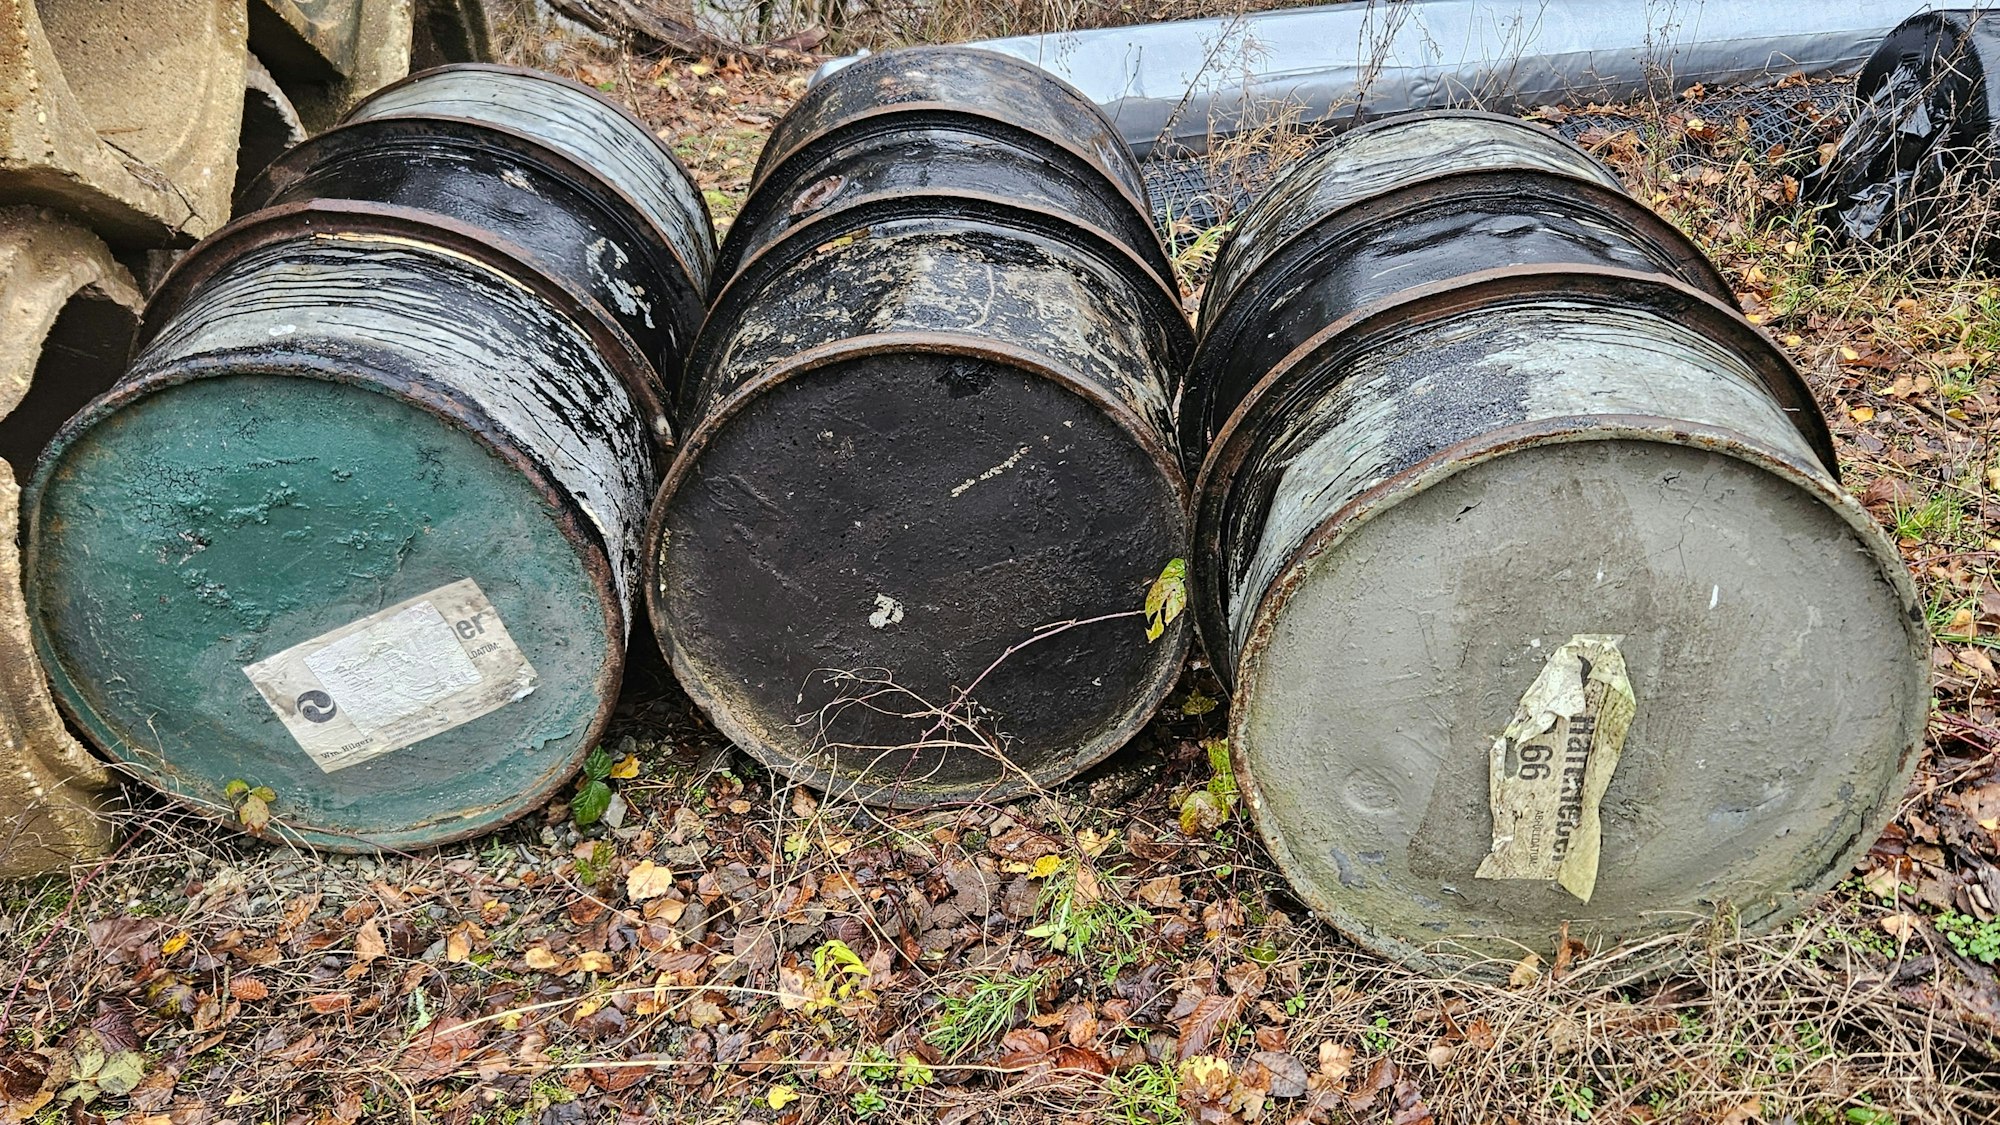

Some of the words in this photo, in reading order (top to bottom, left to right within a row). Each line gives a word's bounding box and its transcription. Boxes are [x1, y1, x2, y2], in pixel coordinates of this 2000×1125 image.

[451, 613, 486, 640] er
[341, 736, 374, 752] Hilgers
[1519, 744, 1553, 781] 66
